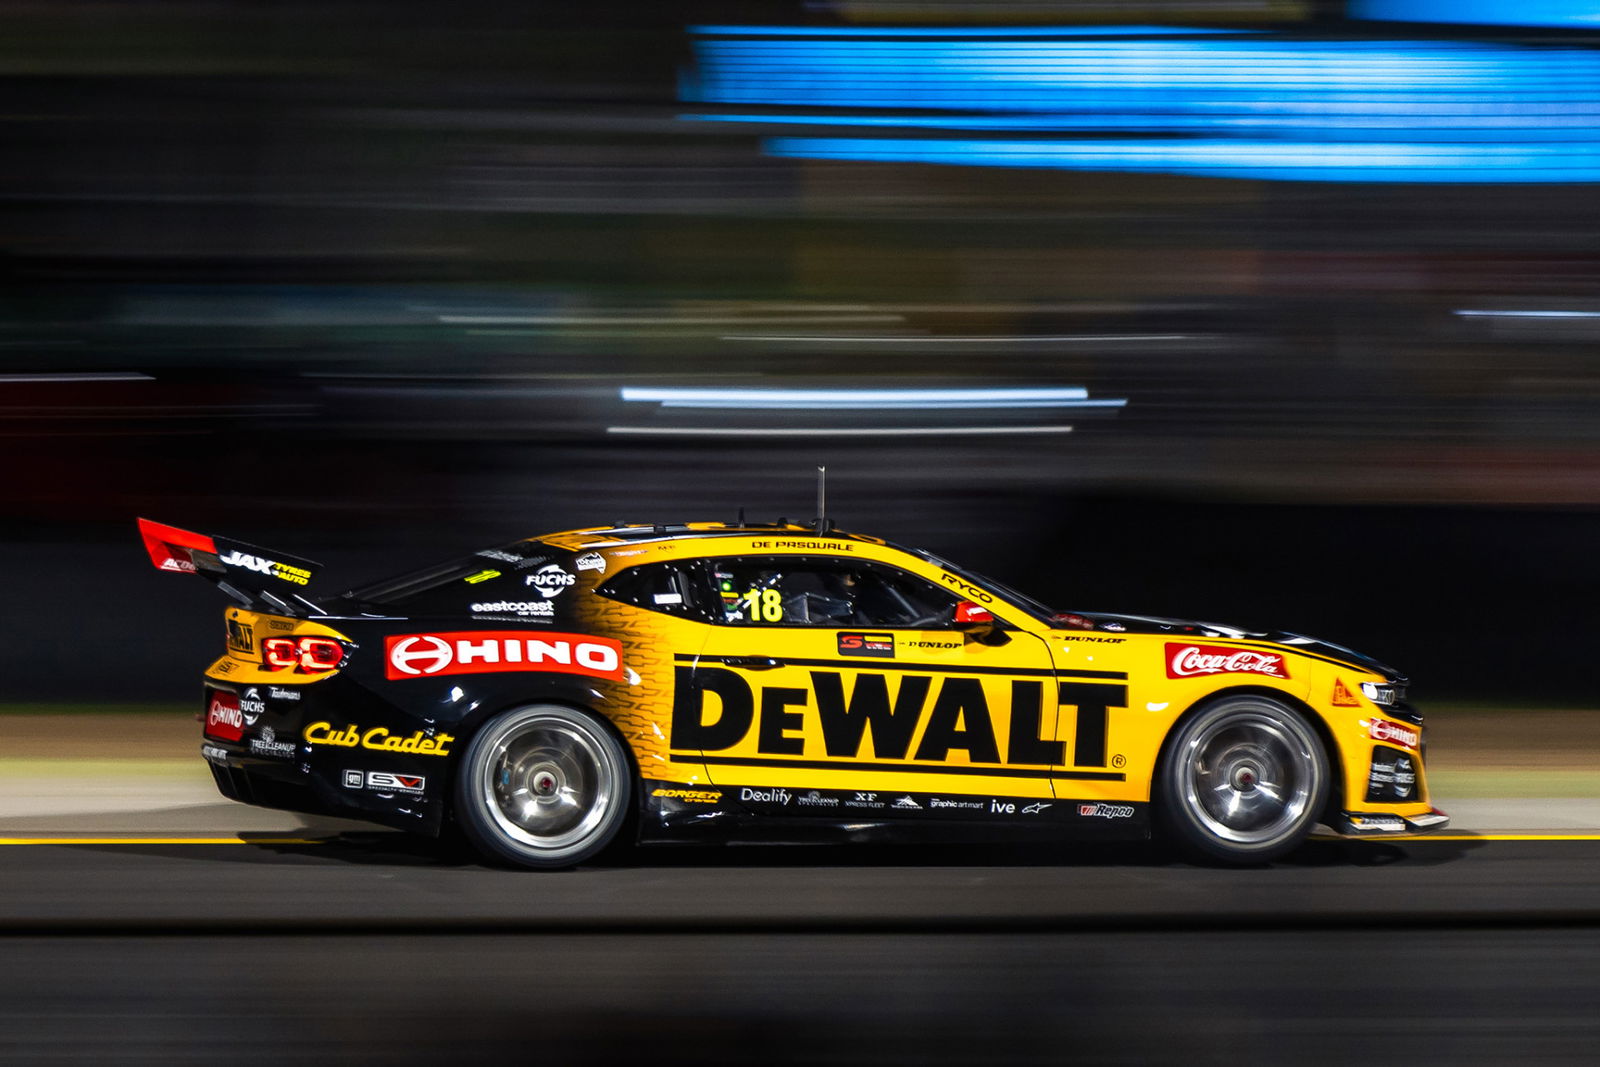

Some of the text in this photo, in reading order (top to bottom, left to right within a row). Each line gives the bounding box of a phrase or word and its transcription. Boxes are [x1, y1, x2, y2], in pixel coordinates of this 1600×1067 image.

[752, 541, 853, 551] DE PASQUALE
[220, 550, 275, 575] JAX
[275, 562, 312, 578] TYRES
[526, 573, 576, 586] FUCHS
[941, 573, 993, 604] RYCO
[471, 600, 554, 612] eastcoast
[743, 588, 783, 622] 18
[908, 641, 963, 649] DUNLOP
[1064, 636, 1126, 644] DUNLOP
[457, 639, 619, 671] HINO
[241, 700, 265, 713] FUCHS
[219, 706, 243, 729] HINO
[303, 721, 455, 757] Cub Cadet
[347, 774, 361, 785] gm
[651, 789, 723, 800] BORGER
[740, 788, 792, 806] Dealify
[855, 792, 878, 802] XF
[930, 799, 958, 808] graphic
[991, 799, 1016, 814] ive
[1094, 803, 1135, 818] Repco
